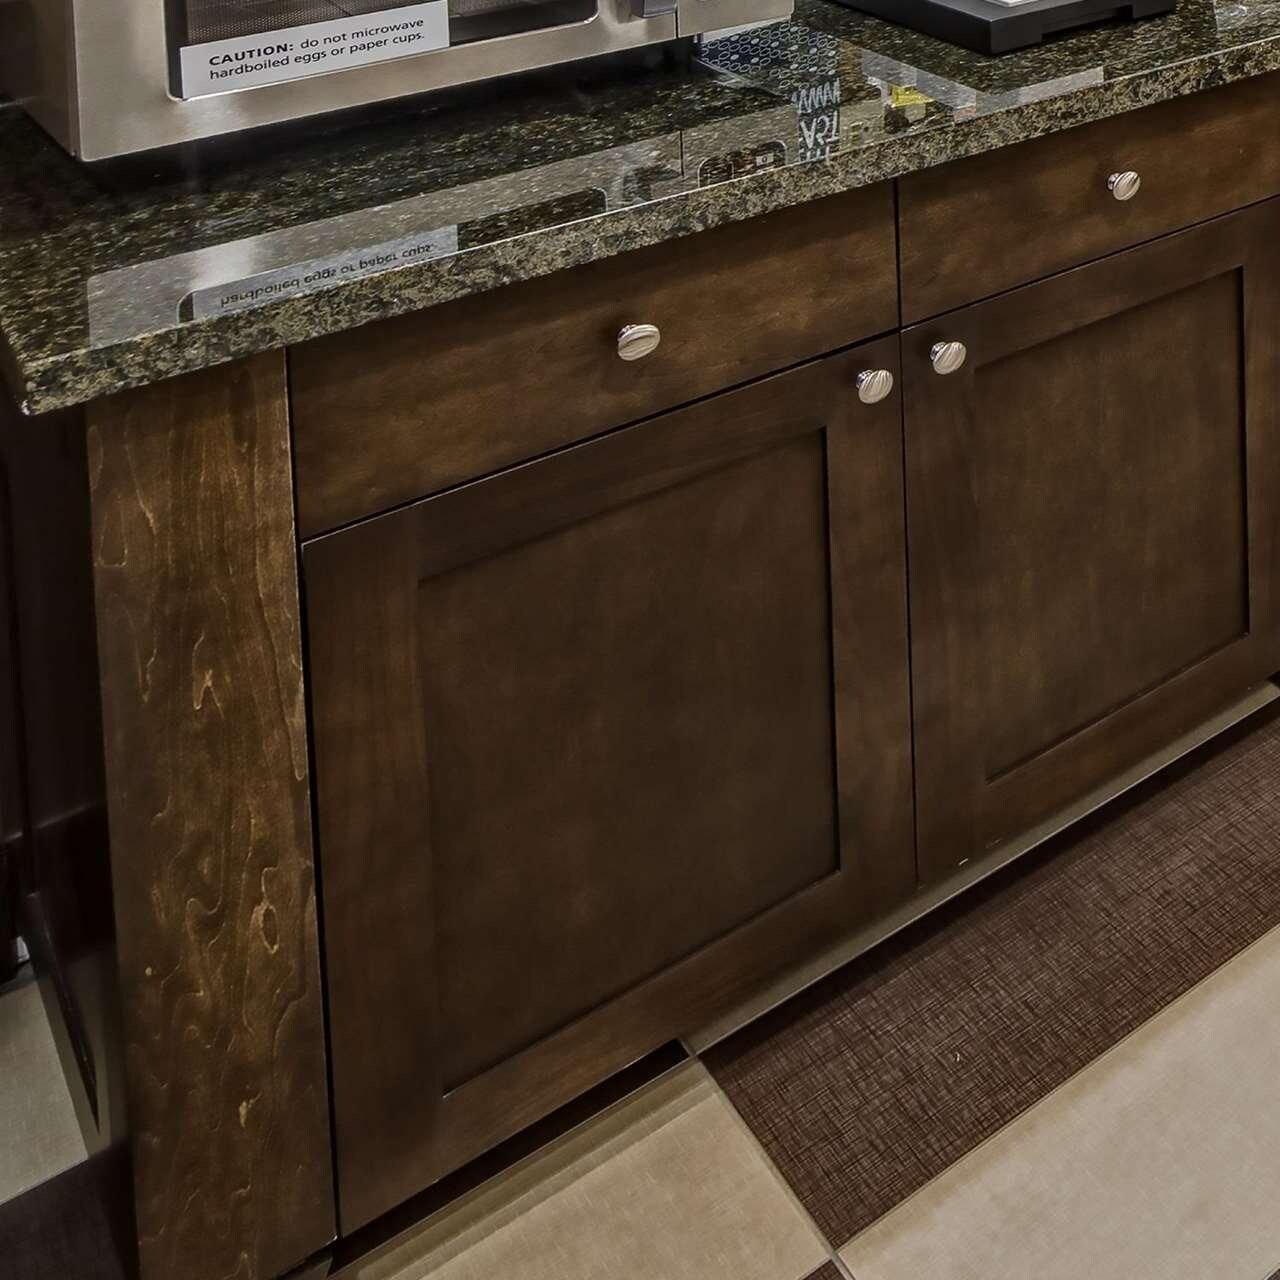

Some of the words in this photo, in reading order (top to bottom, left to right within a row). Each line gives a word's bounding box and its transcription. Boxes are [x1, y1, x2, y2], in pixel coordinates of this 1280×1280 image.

[209, 42, 294, 67] CAUTION:
[300, 37, 319, 50] do
[323, 32, 348, 46] not
[351, 18, 424, 41] microwave
[210, 55, 290, 81] hardboiled
[294, 49, 327, 66] eggs
[330, 45, 345, 56] or
[349, 37, 389, 56] paper
[392, 31, 425, 48] cups.
